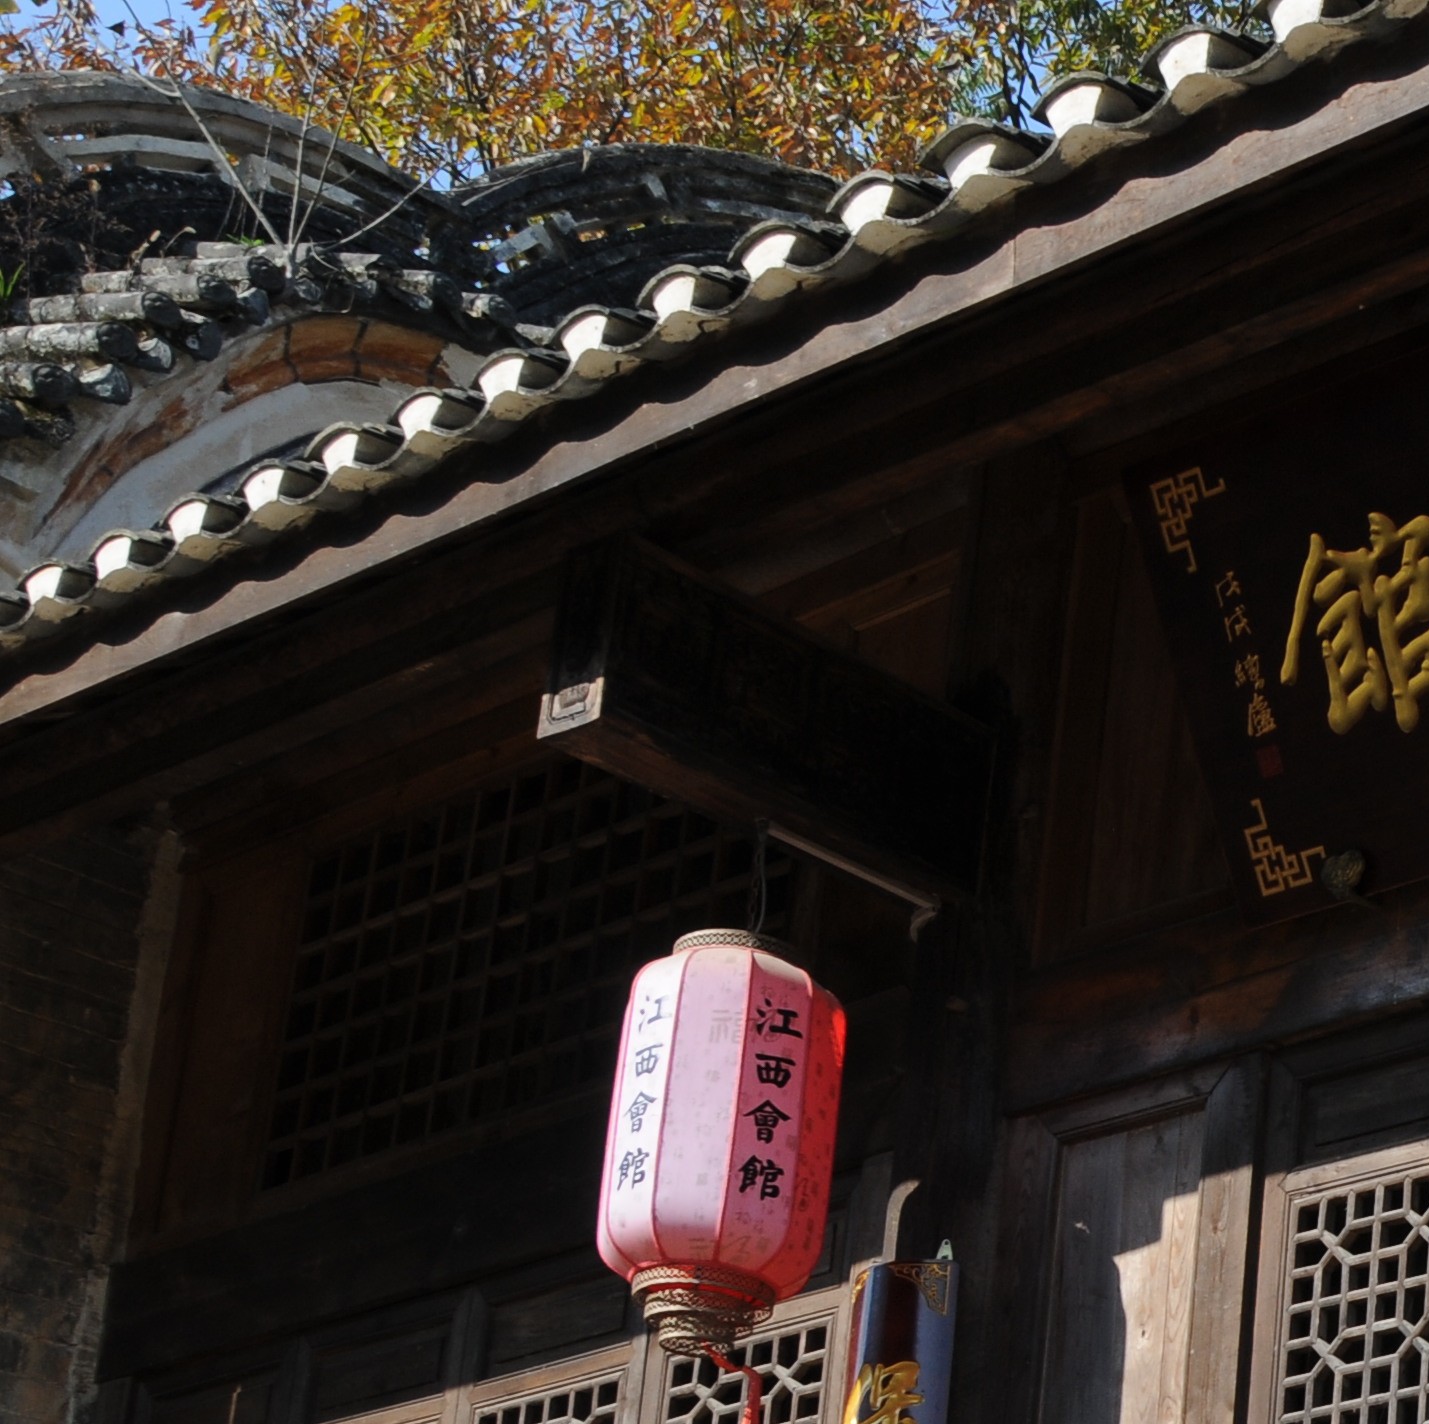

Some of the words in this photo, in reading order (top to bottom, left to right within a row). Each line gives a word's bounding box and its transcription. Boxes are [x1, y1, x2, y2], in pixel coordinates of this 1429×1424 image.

[616, 994, 673, 1191] 江西會館
[738, 998, 804, 1201] 江西會館
